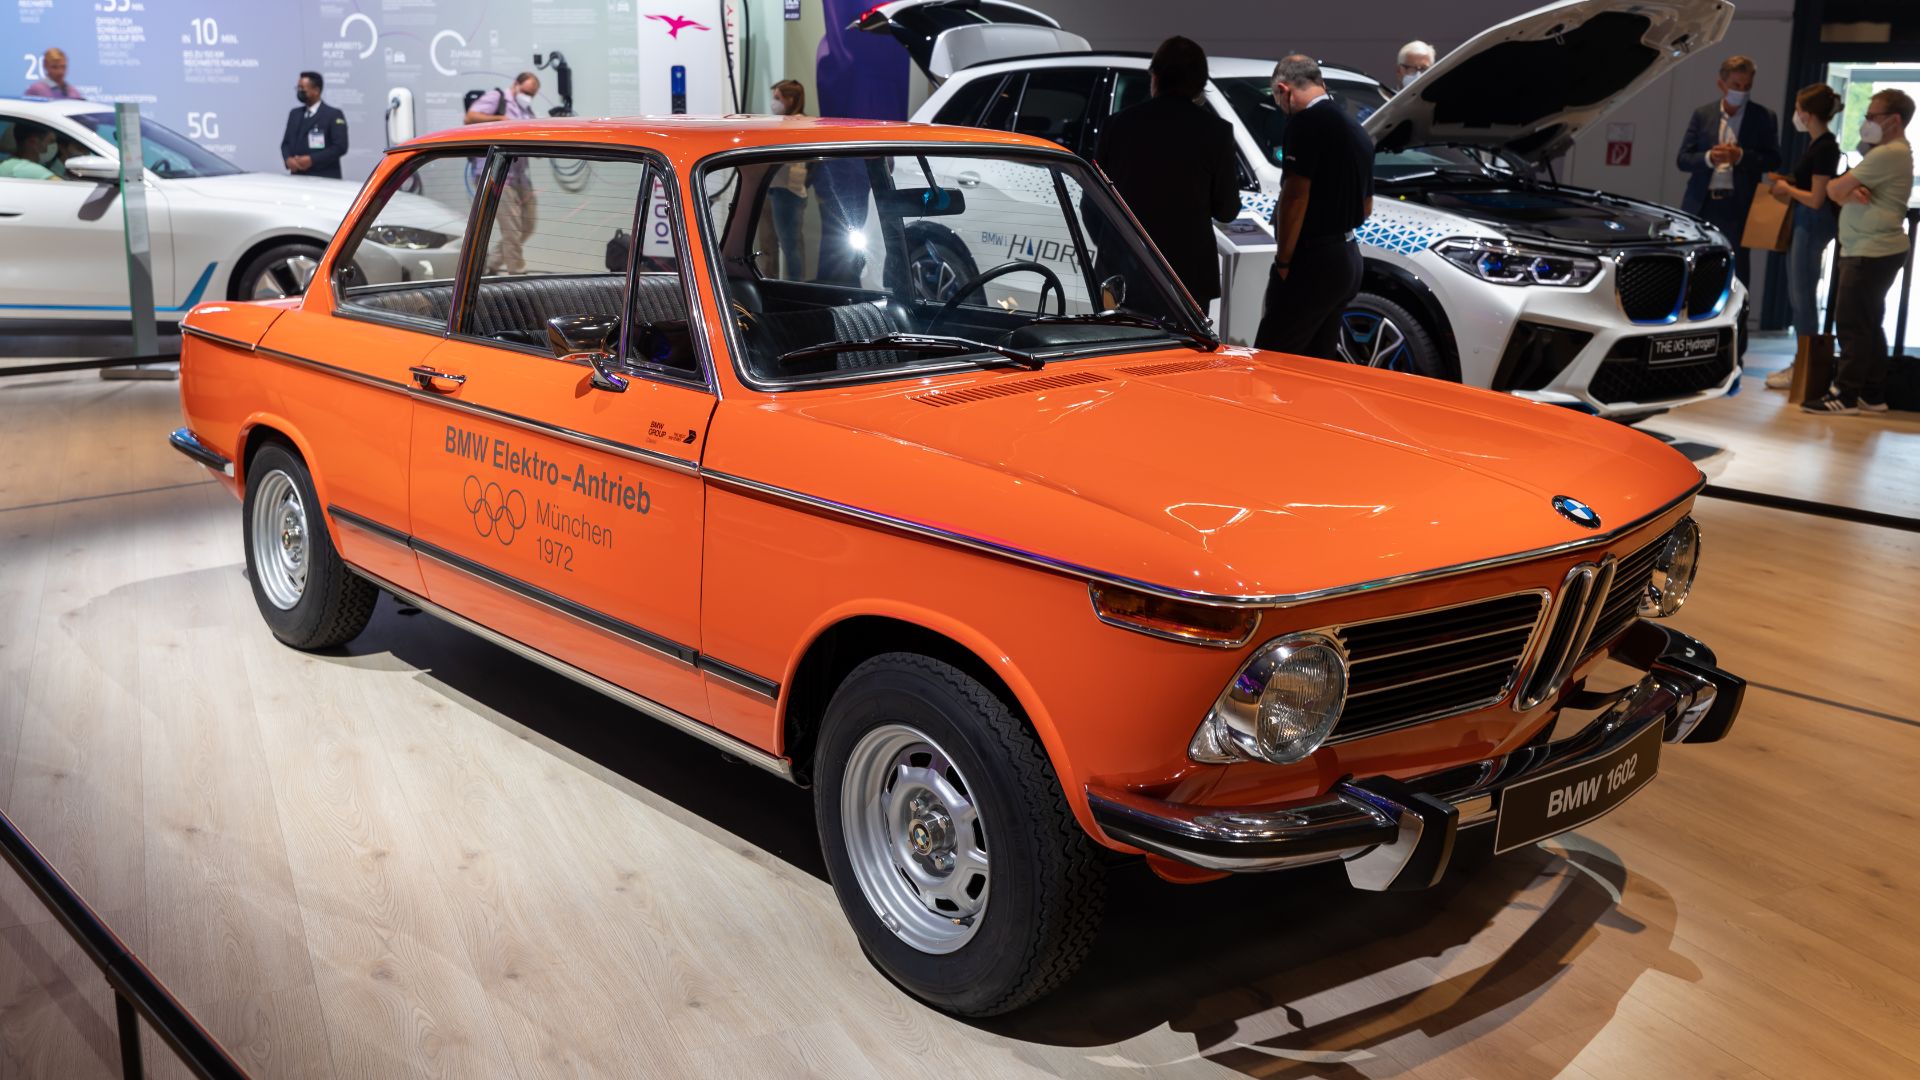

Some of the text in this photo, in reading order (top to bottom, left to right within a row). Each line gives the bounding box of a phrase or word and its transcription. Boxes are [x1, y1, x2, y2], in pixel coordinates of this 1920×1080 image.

[191, 17, 218, 46] 10
[187, 111, 220, 139] 5G
[981, 231, 1003, 246] BMW
[1655, 340, 1673, 354] THE
[1685, 337, 1716, 352] Hydrogen
[648, 428, 667, 438] GROUP
[650, 420, 665, 430] BMW
[445, 425, 651, 515] BMW Elektro-Antrieb
[536, 498, 613, 549] München
[536, 535, 574, 572] 1972
[1546, 752, 1638, 818] BMW 1602
